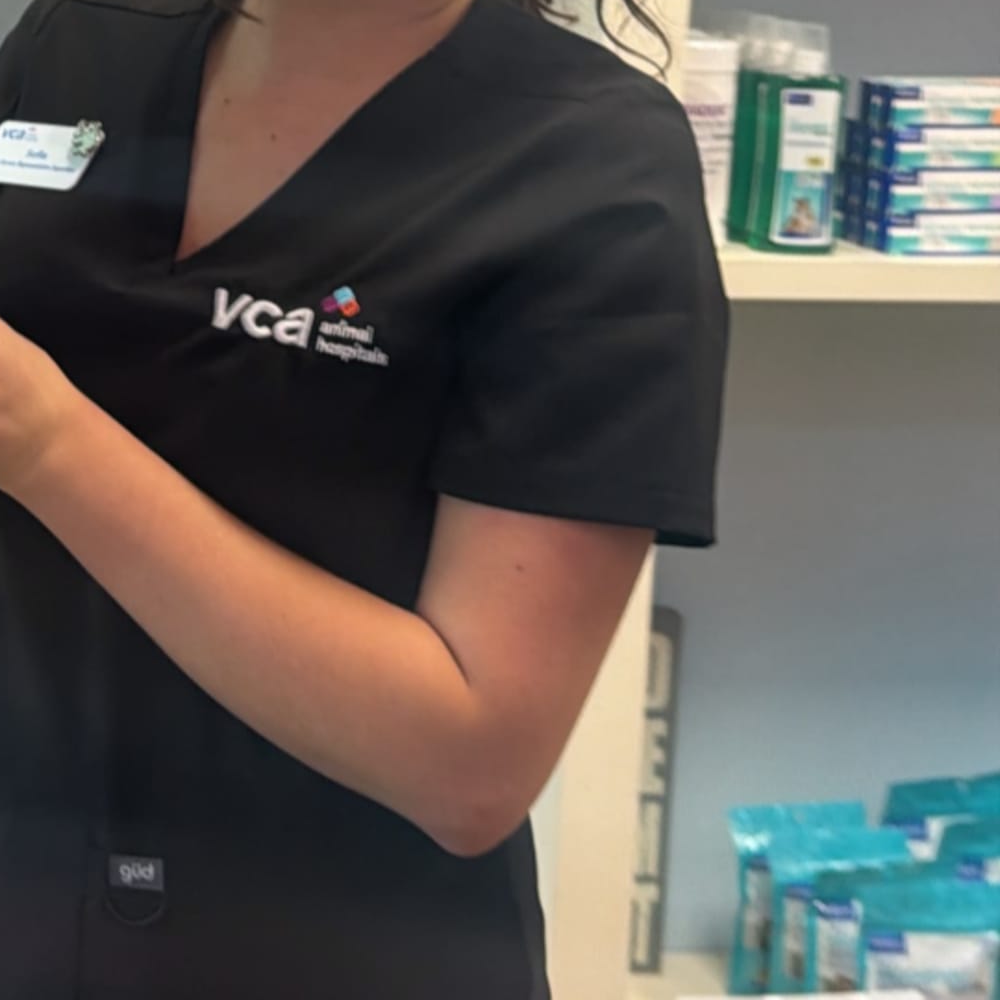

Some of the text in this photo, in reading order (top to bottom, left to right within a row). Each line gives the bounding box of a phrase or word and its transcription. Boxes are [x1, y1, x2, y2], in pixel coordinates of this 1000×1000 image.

[211, 286, 315, 349] vca
[318, 320, 374, 344] animal
[315, 335, 390, 367] hospitals
